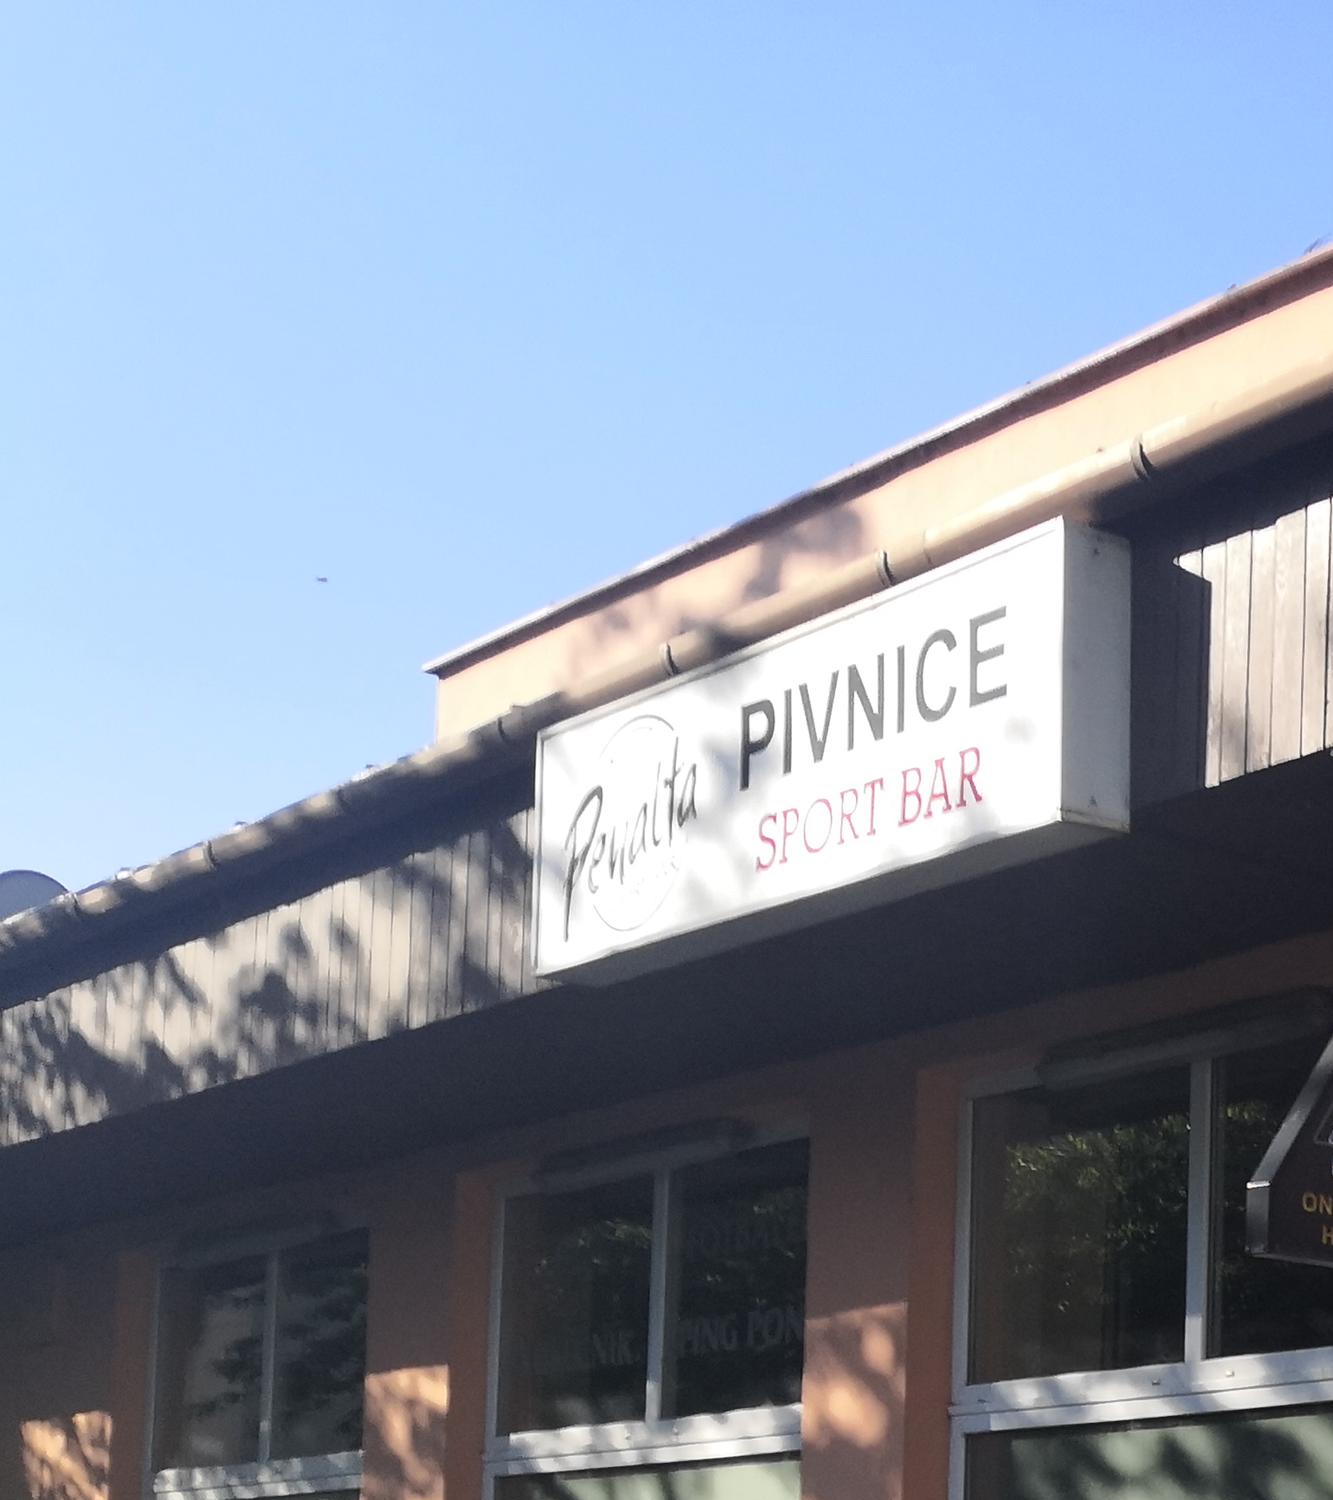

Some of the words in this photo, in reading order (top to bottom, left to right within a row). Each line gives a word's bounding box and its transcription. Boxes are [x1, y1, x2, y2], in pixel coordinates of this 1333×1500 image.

[740, 606, 1008, 791] PIVNICE
[563, 735, 697, 942] Penalta
[756, 779, 882, 872] SPORT
[898, 747, 983, 827] BAR
